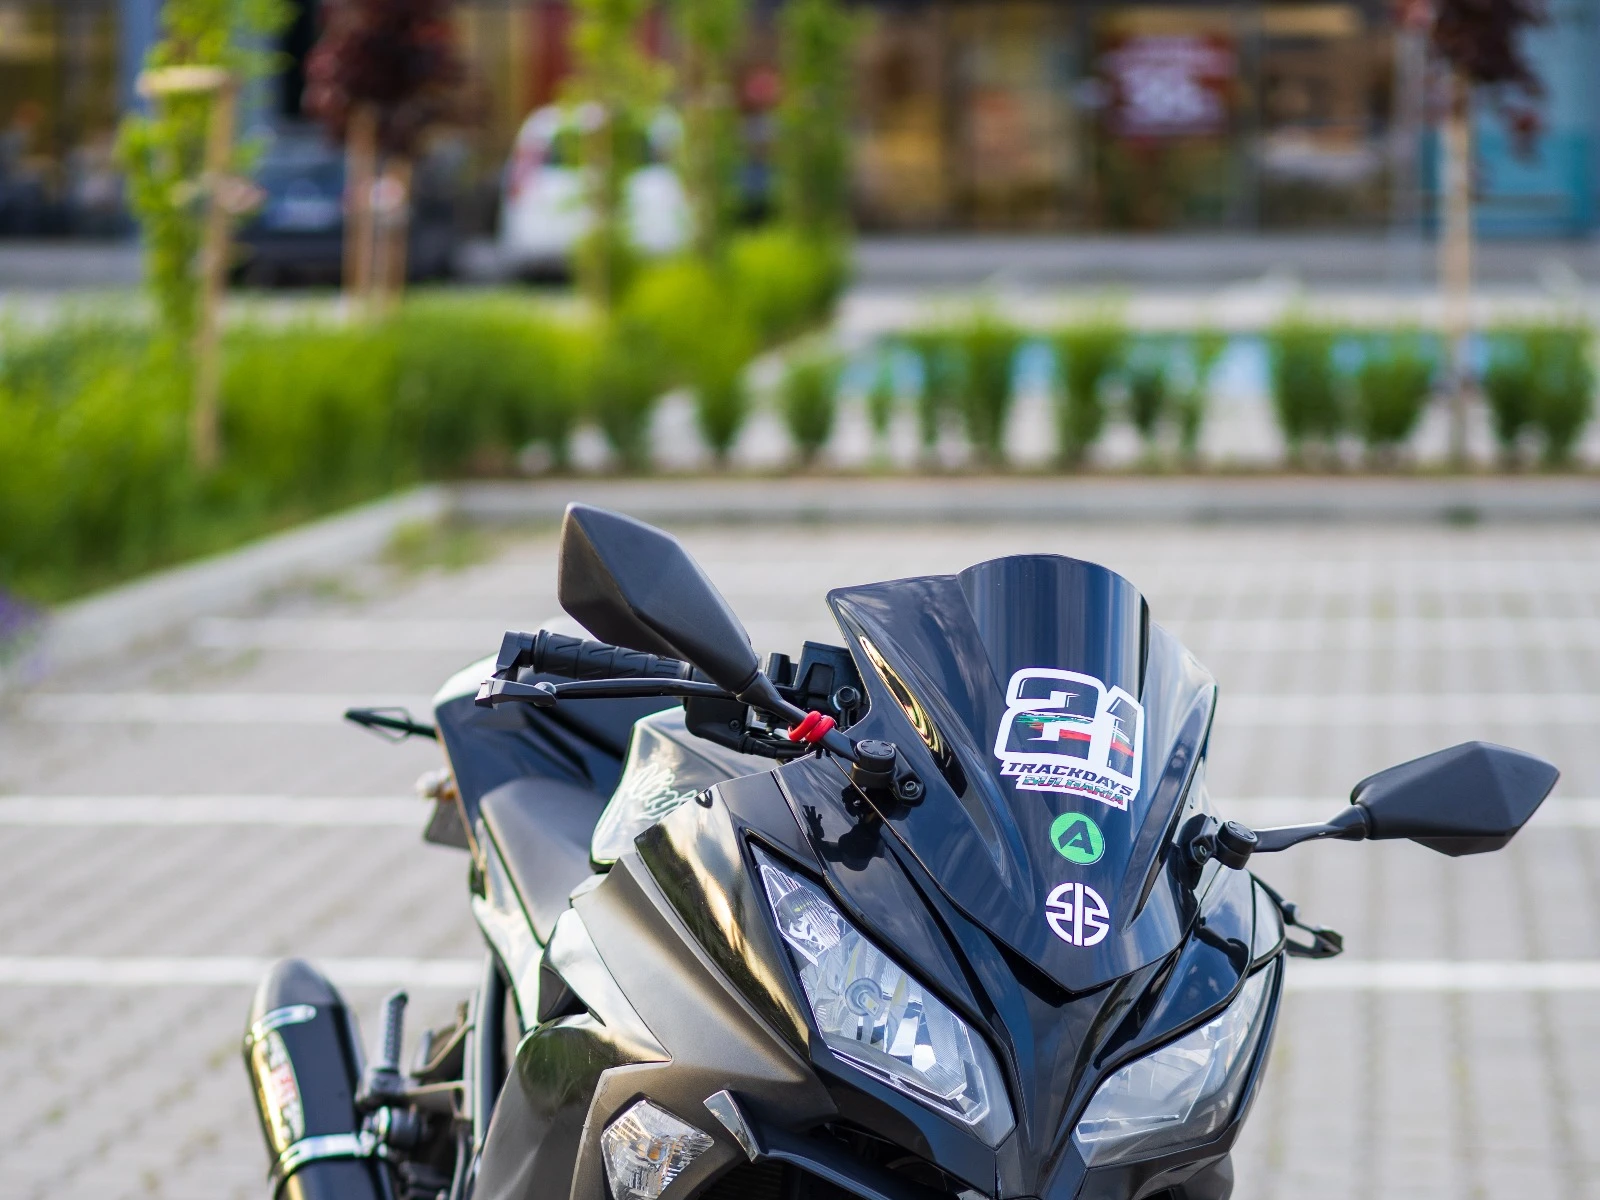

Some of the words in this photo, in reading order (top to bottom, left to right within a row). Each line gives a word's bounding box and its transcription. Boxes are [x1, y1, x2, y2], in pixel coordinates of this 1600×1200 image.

[1008, 762, 1134, 797] TRACKDAYS
[1022, 775, 1124, 806] BULGARIA
[1057, 819, 1095, 856] A
